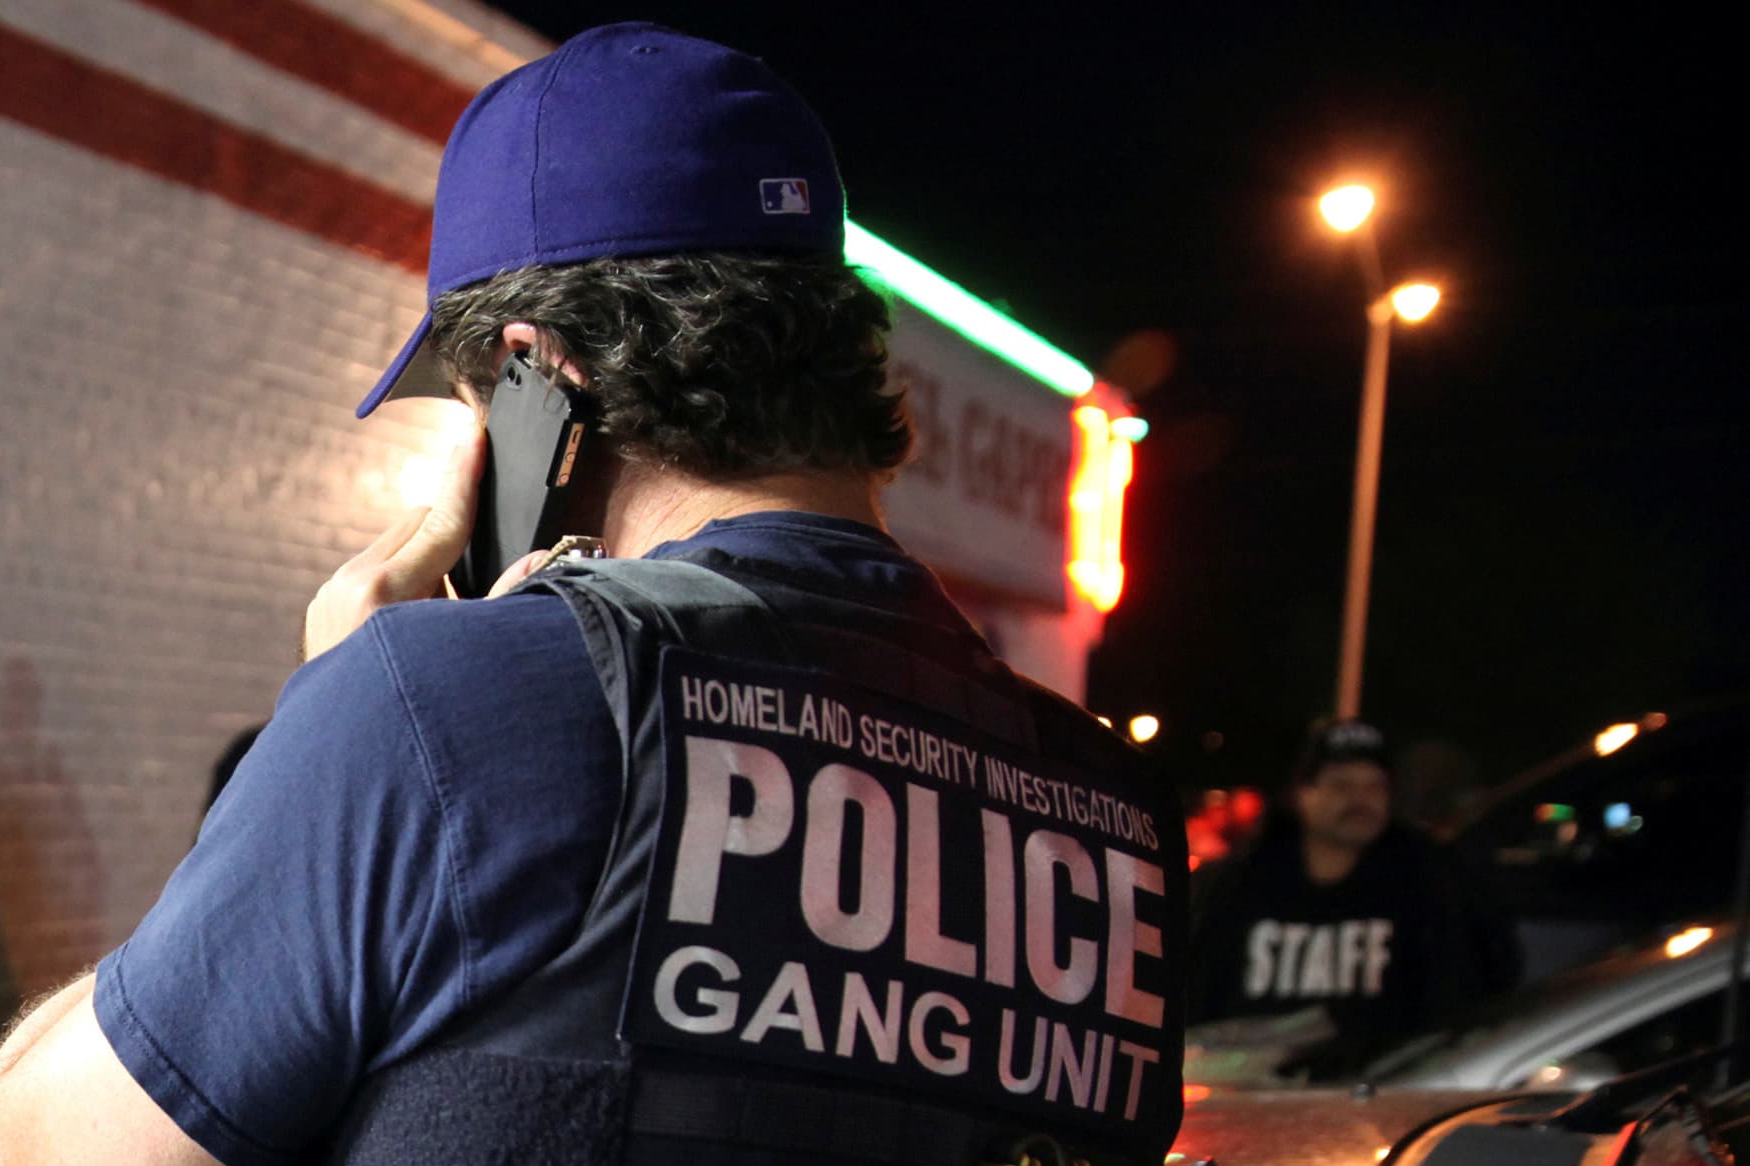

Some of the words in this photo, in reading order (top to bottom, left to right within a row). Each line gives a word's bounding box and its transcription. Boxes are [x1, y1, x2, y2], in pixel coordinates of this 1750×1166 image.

[681, 675, 853, 750] HOMELAND
[859, 714, 979, 789] SECURITY
[984, 755, 1160, 851] INVESTIGATIONS
[667, 734, 1166, 1029] POLICE
[1245, 918, 1394, 997] STAFF
[652, 945, 972, 1077] GANG
[997, 1008, 1161, 1122] UNIT
